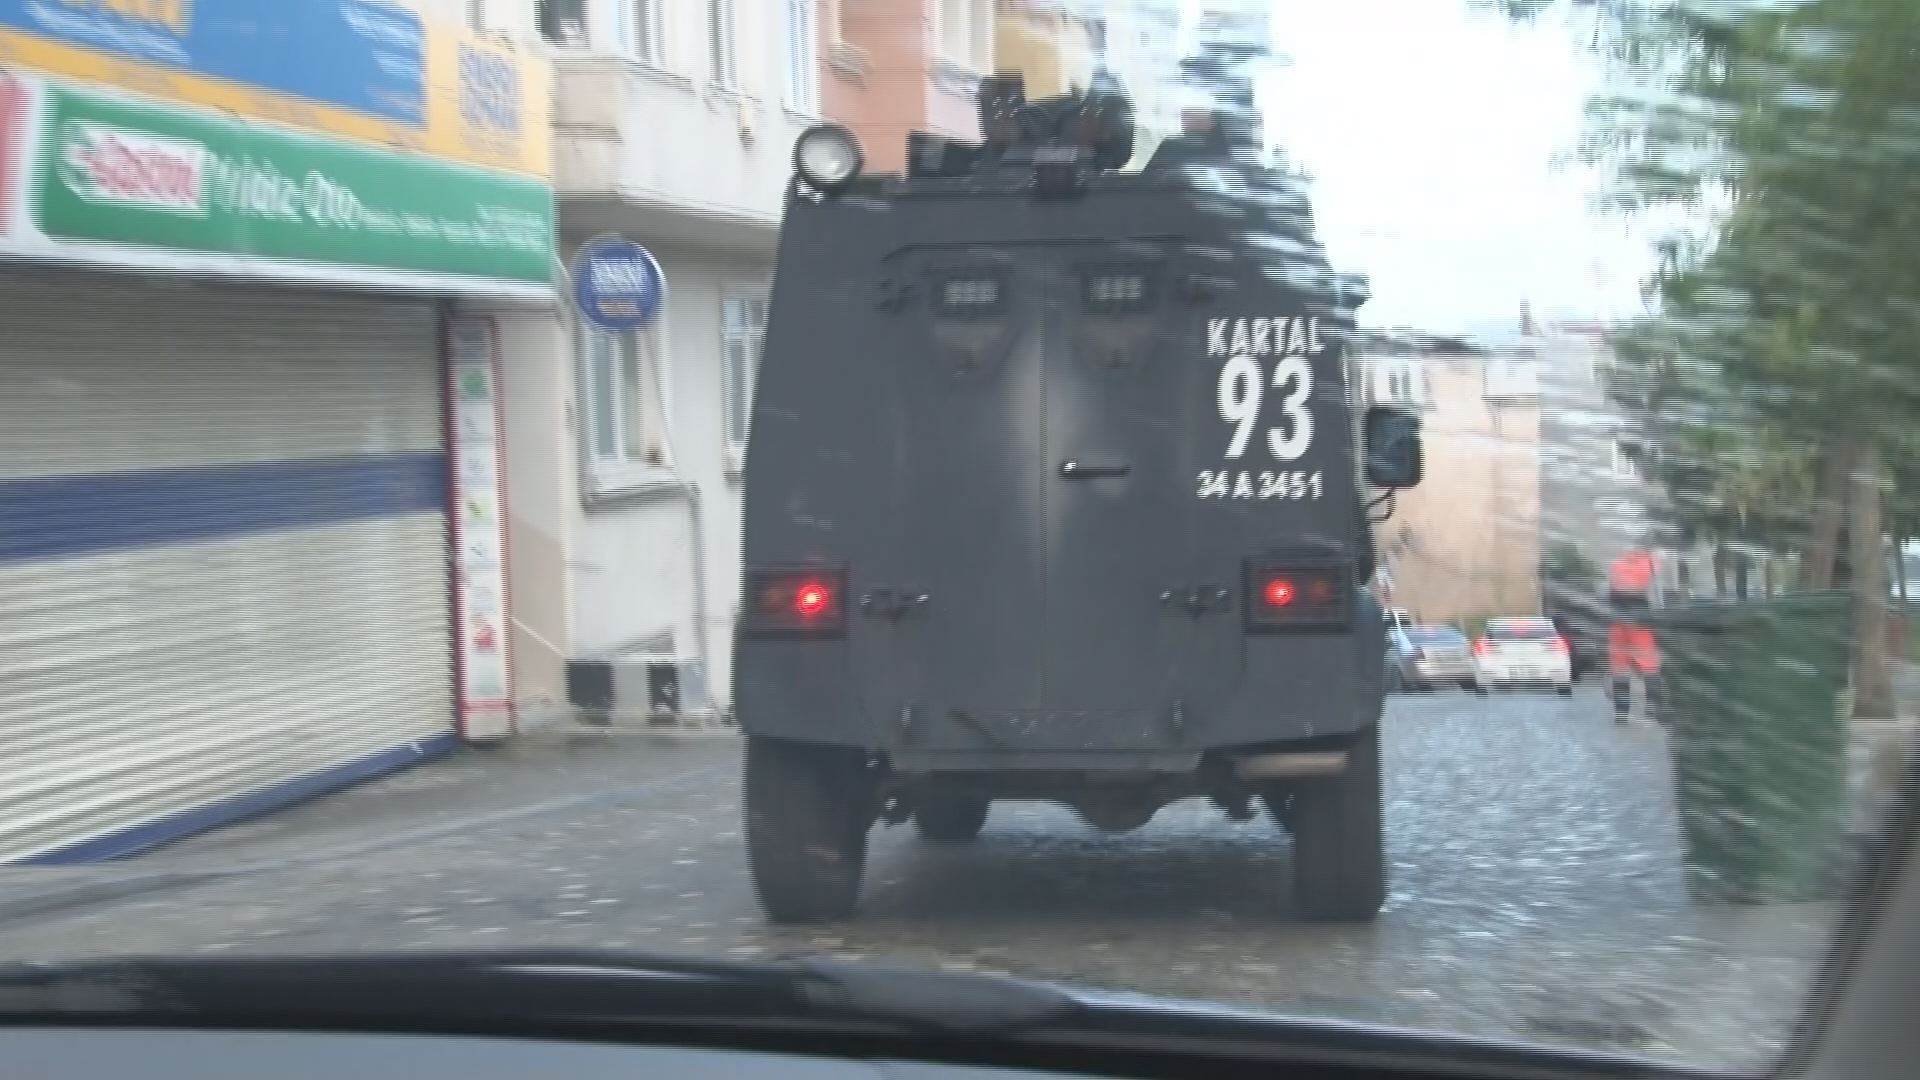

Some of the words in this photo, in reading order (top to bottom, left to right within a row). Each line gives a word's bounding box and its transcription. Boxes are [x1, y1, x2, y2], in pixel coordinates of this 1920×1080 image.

[303, 170, 362, 230] Oto
[1208, 316, 1325, 356] KARTAL
[1217, 354, 1315, 461] 93
[1196, 470, 1229, 500] 34
[1232, 471, 1254, 499] A
[1257, 470, 1323, 500] 3451
